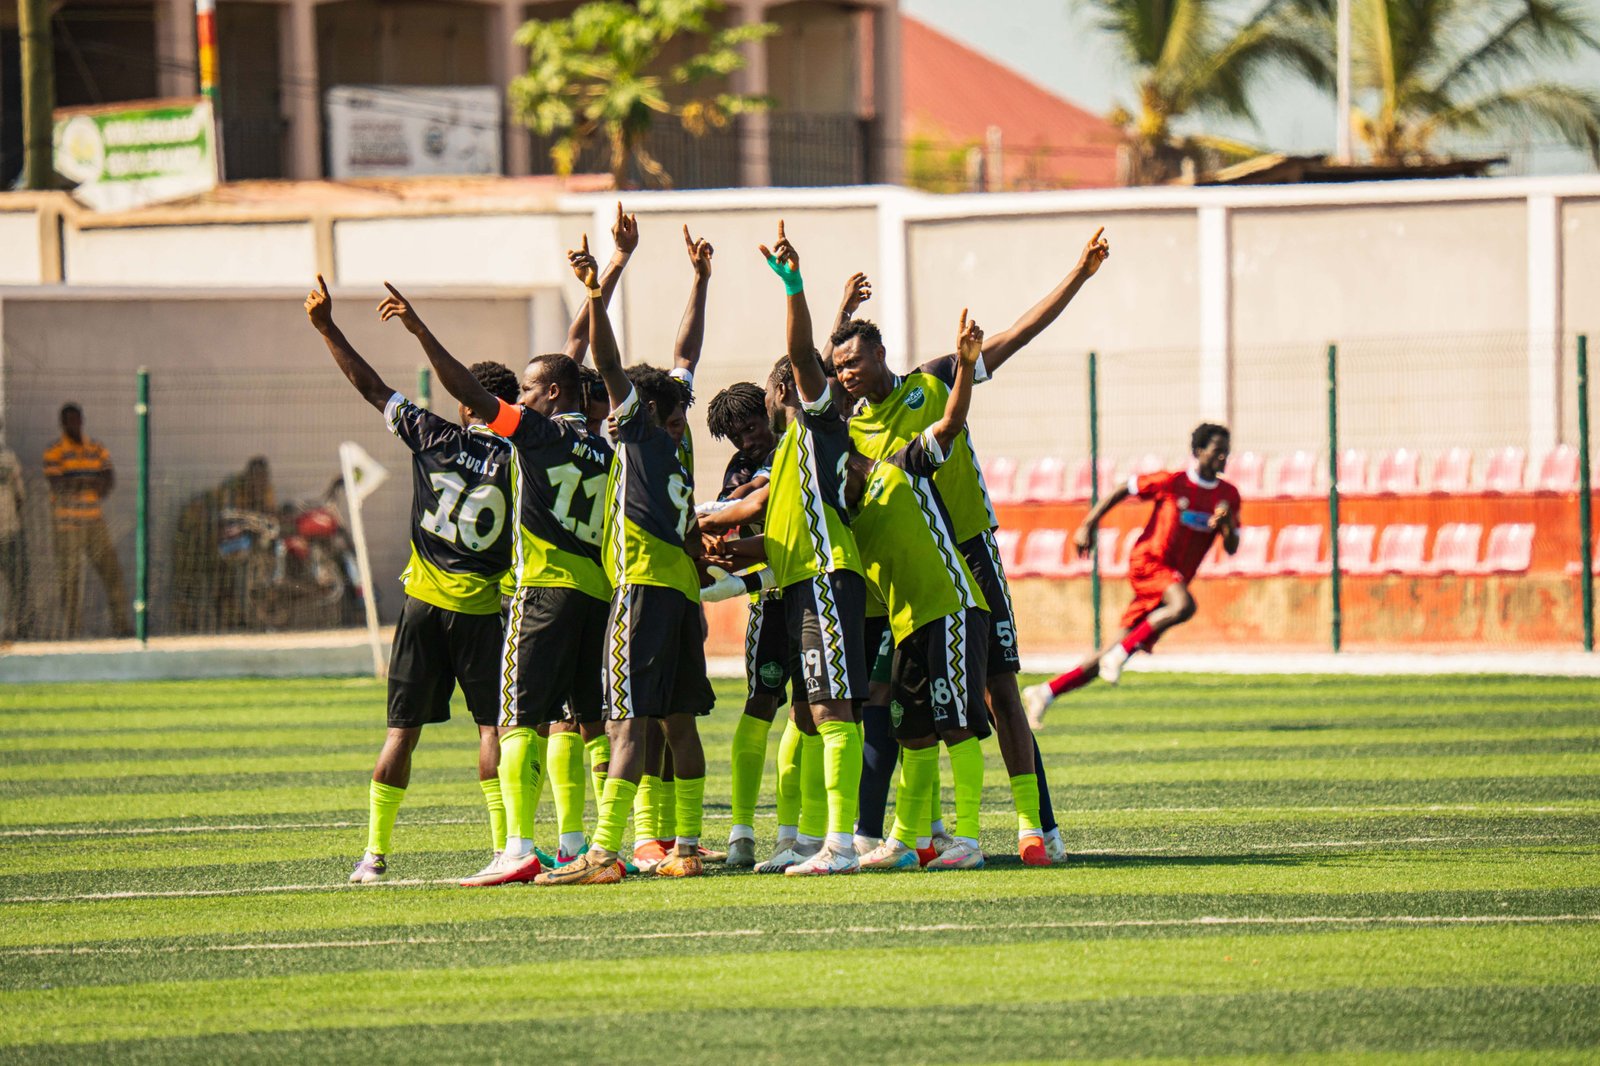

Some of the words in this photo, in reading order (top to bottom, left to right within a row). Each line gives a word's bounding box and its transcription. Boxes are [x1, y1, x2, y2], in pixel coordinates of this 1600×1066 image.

[456, 451, 500, 477] SURAJ
[420, 471, 506, 551] 10
[546, 462, 609, 547] 11
[996, 620, 1013, 648] 5
